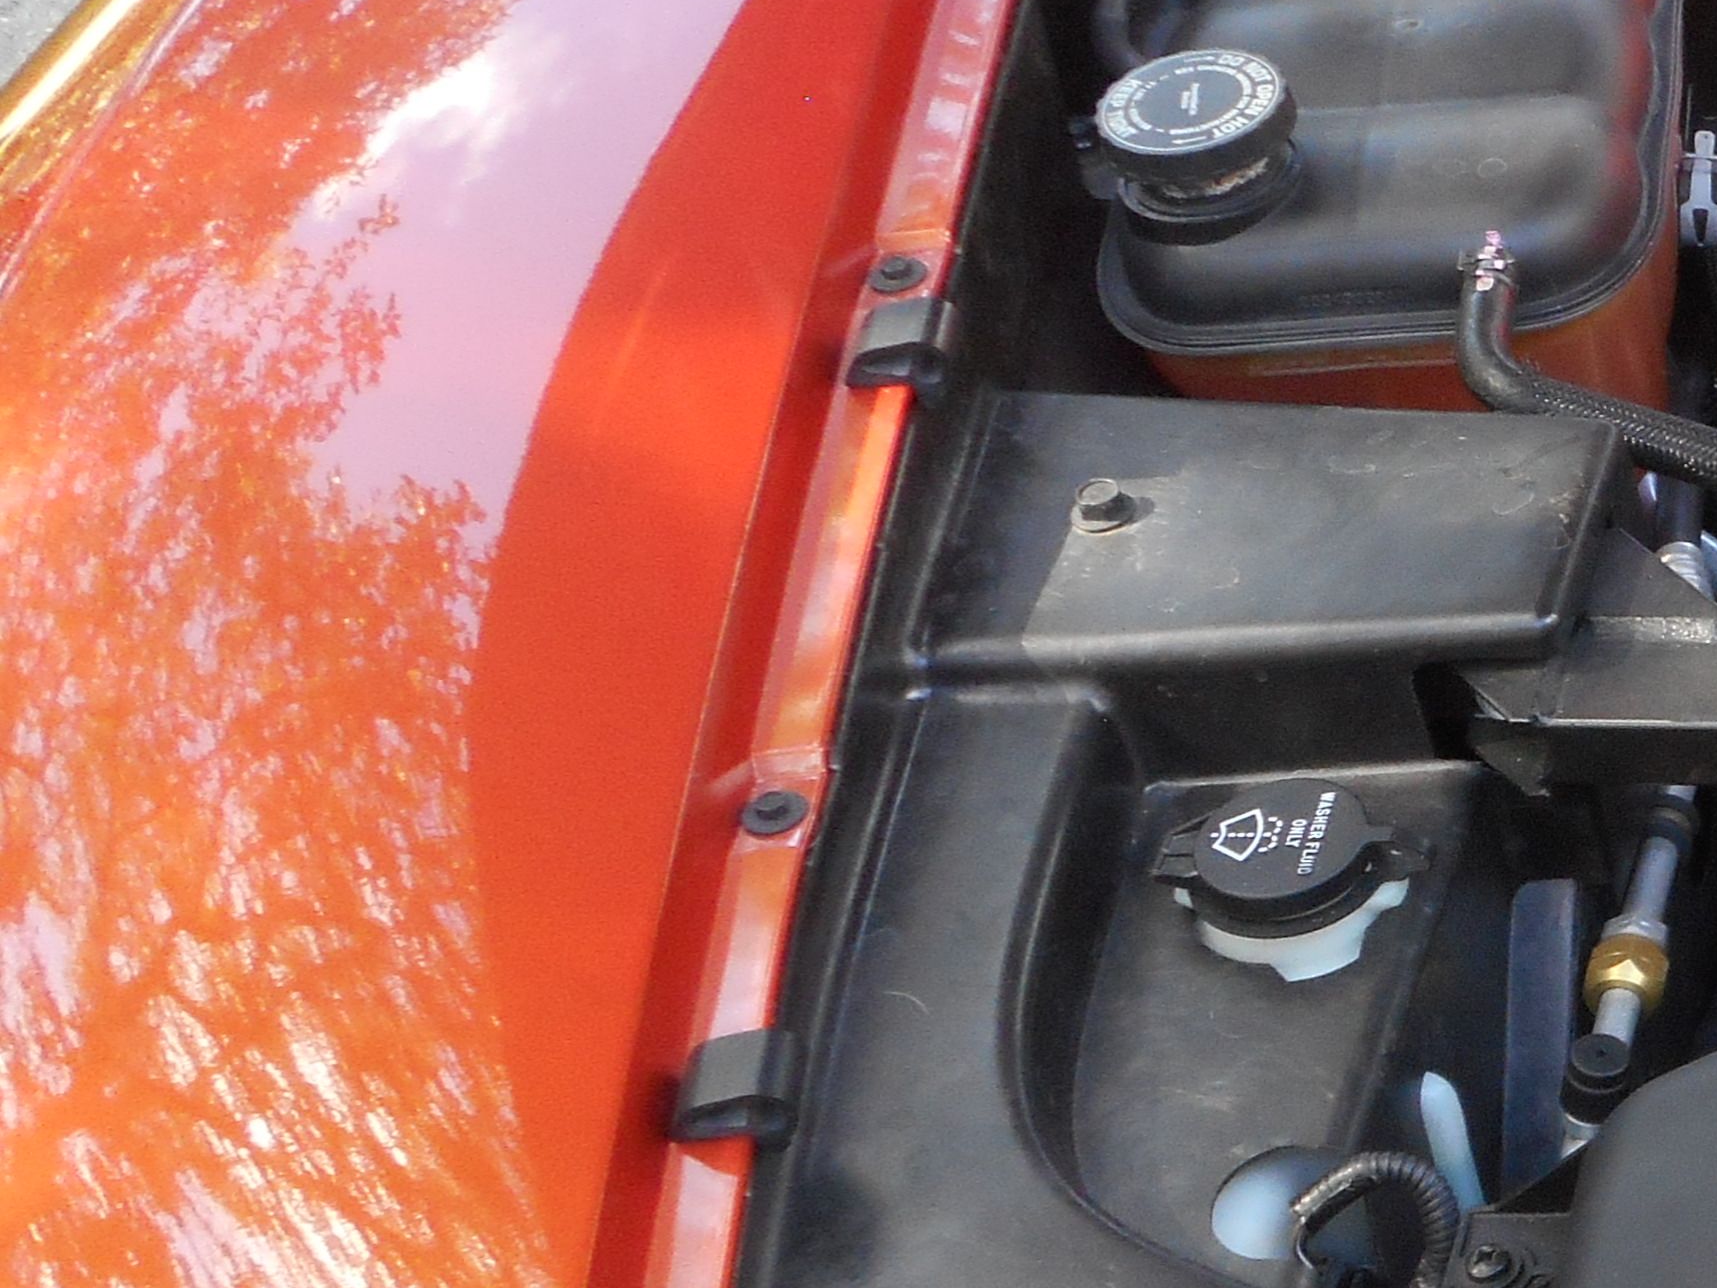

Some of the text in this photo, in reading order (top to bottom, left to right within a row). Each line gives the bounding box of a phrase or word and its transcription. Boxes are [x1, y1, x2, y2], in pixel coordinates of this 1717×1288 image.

[1107, 79, 1143, 138] KEEP TIGHT
[1212, 55, 1275, 137] DO NOT OPEN HOT
[1285, 819, 1307, 847] ONLY
[1297, 792, 1336, 874] WASHER FLUID
